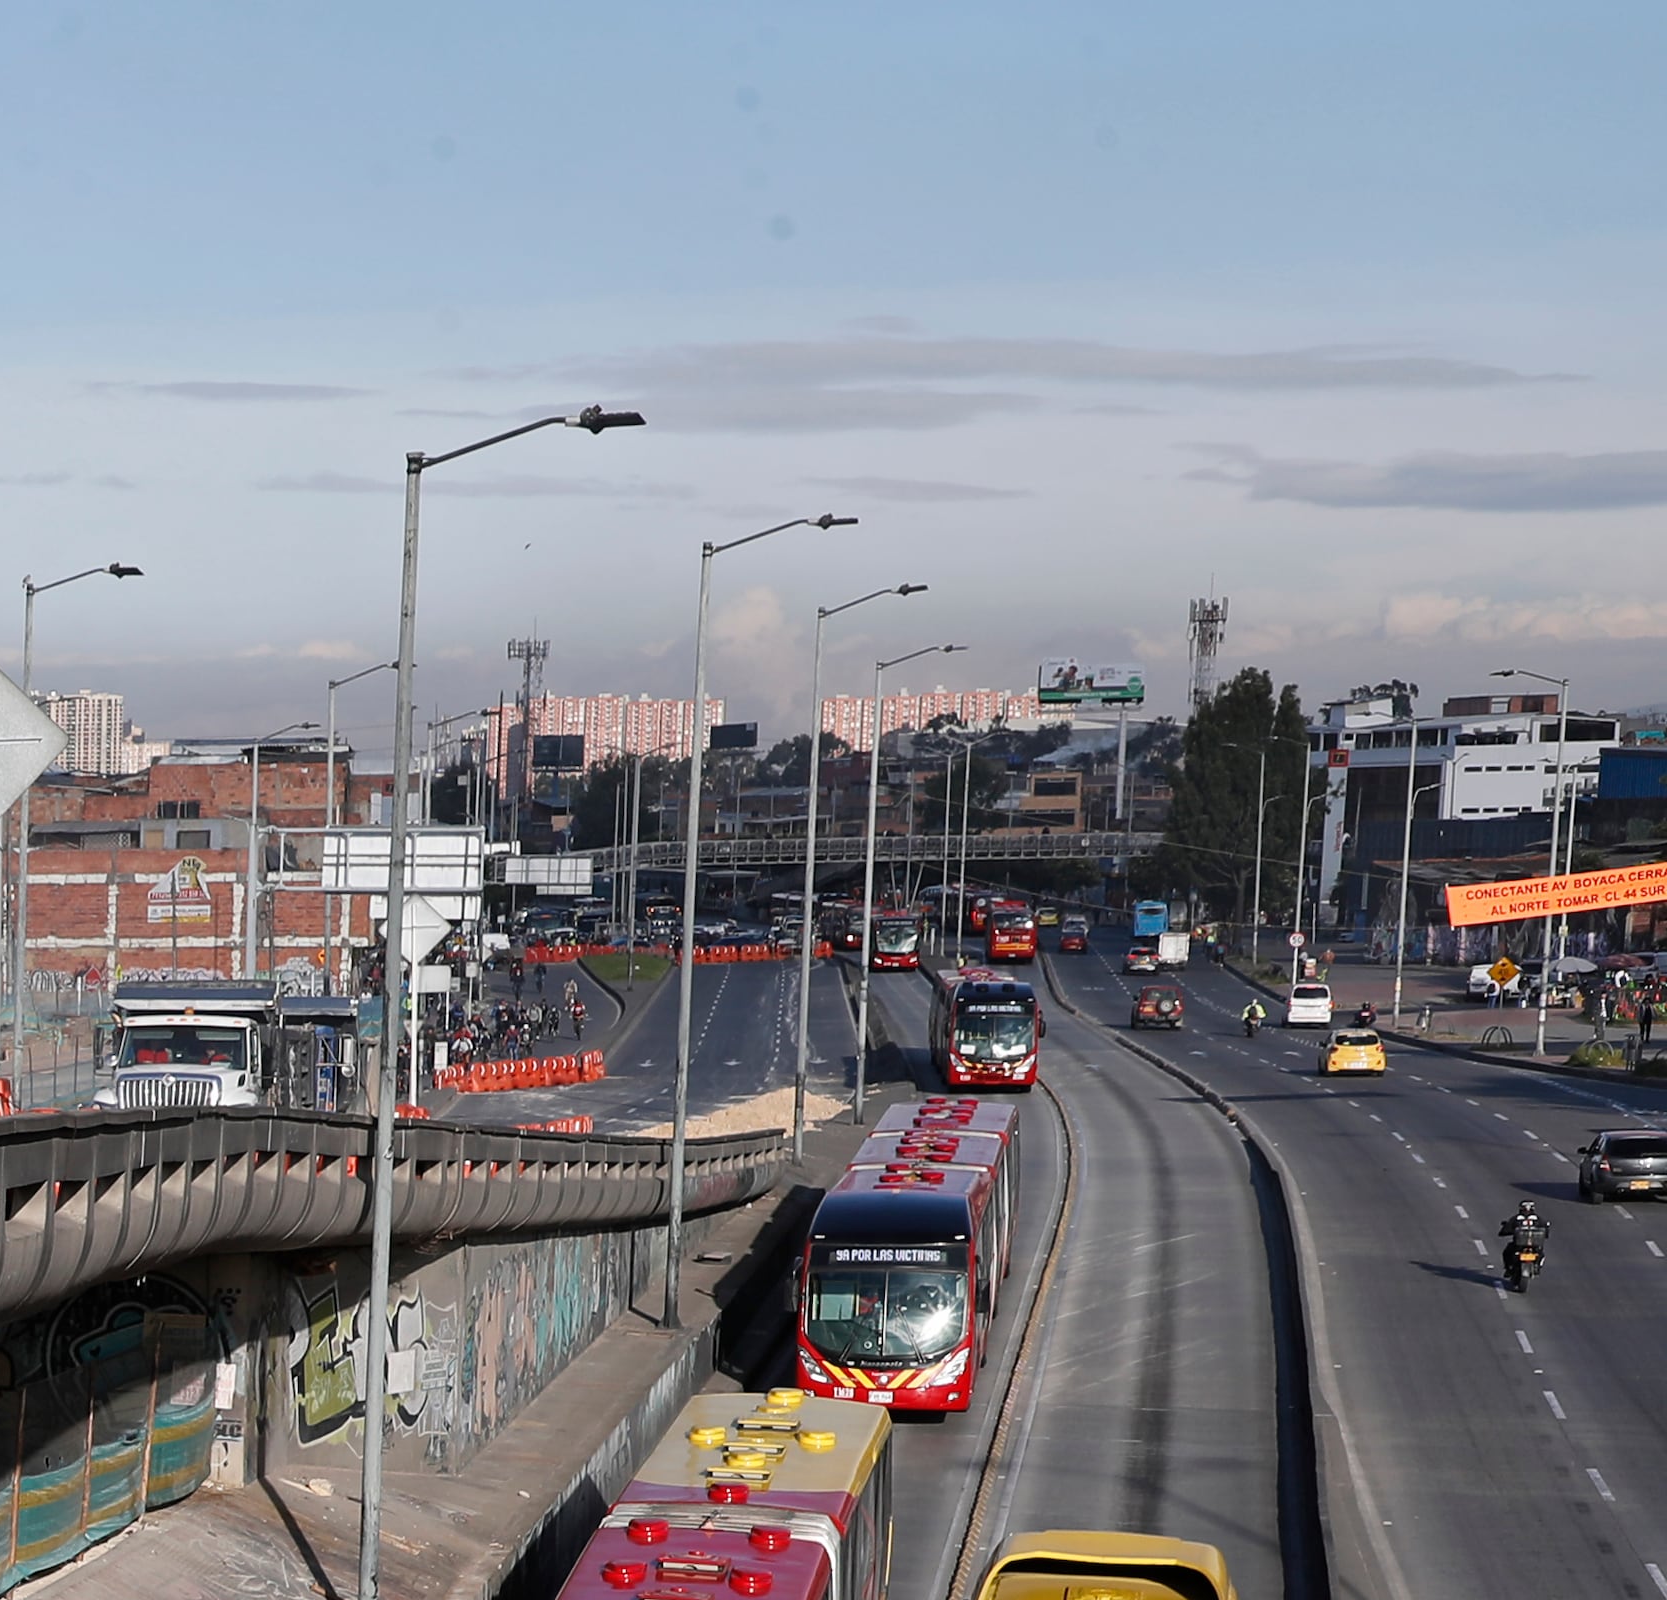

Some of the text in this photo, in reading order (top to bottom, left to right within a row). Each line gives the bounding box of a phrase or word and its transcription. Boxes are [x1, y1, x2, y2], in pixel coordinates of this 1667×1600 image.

[1466, 883, 1549, 900] CONECTANTE
[1551, 881, 1567, 892] AV
[1573, 873, 1625, 889] BOYACA
[1491, 885, 1665, 916] AL NORTE TOMAR CL 44 SUR
[1292, 935, 1303, 945] 50
[851, 1249, 871, 1261] POR
[873, 1249, 893, 1261] LAS
[895, 1249, 941, 1261] VICTIMAS
